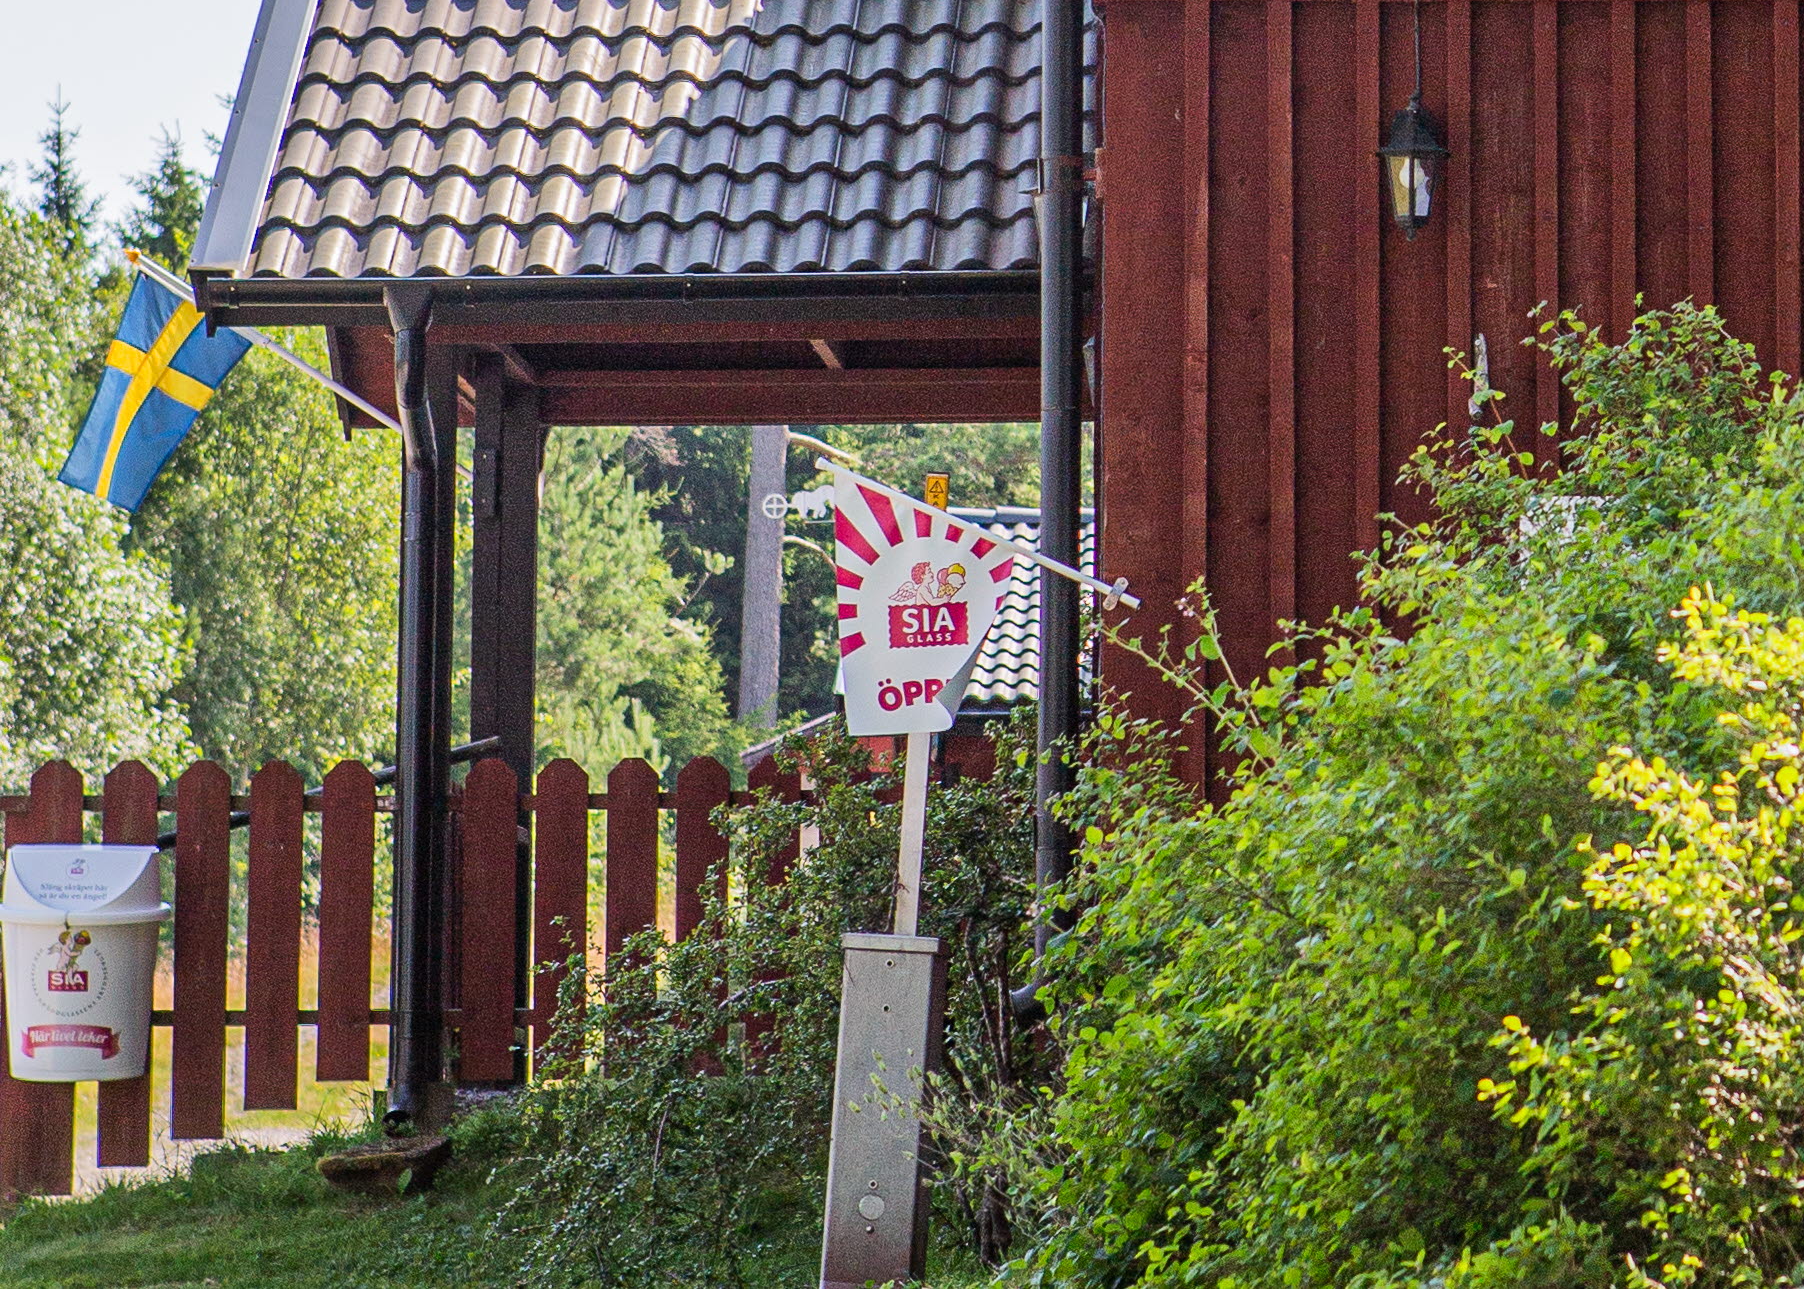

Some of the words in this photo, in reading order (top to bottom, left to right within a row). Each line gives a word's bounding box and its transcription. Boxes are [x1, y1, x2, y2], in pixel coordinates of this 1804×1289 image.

[902, 607, 955, 634] SIA
[906, 632, 952, 643] GLASS
[878, 678, 952, 711] ÖPP
